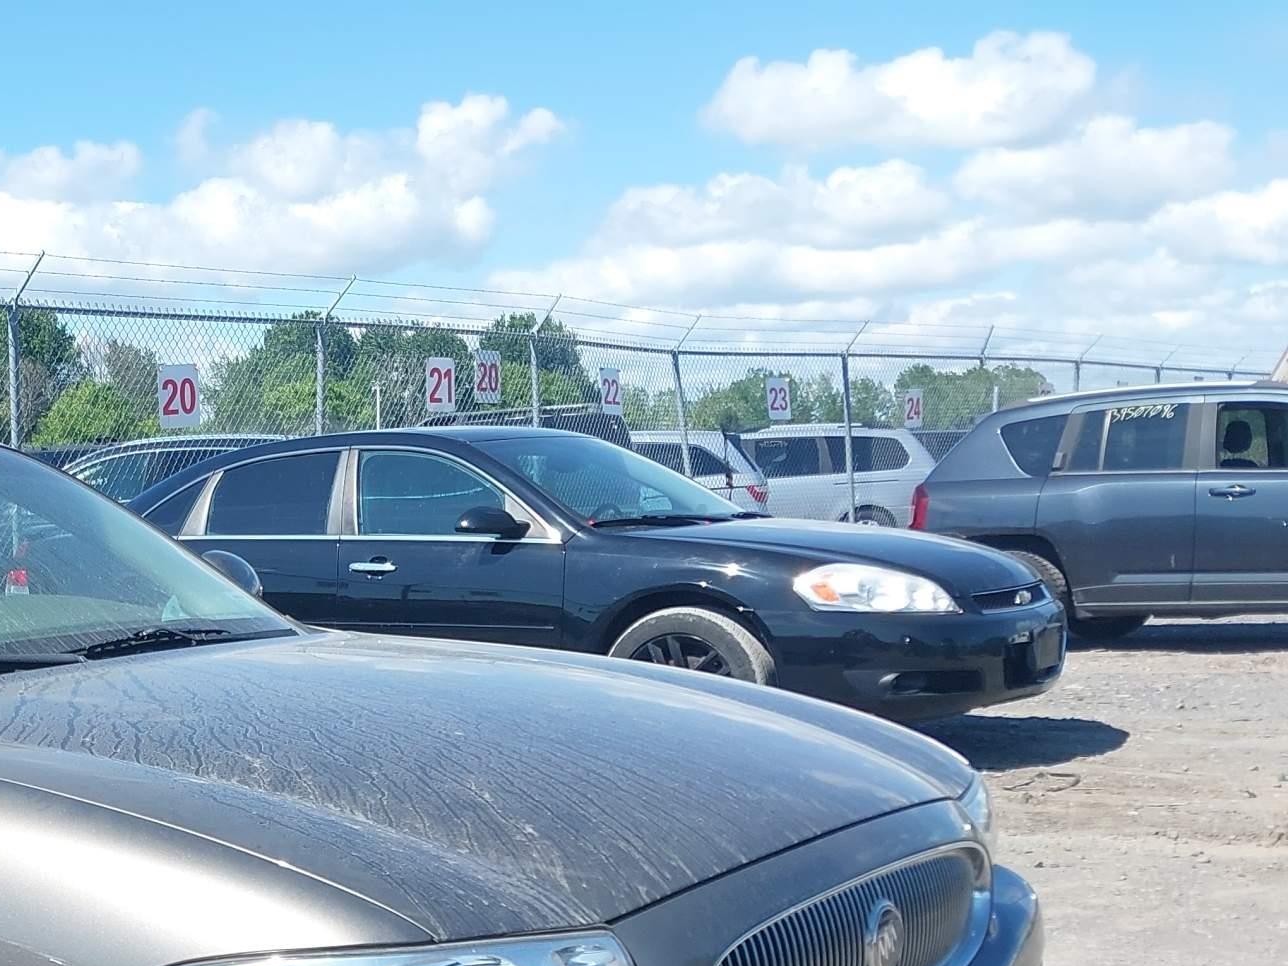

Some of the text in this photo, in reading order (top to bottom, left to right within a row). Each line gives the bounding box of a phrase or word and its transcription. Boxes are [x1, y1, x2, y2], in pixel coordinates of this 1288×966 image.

[429, 367, 453, 404] 21
[477, 362, 499, 393] 20
[162, 378, 196, 416] 20
[603, 378, 620, 405] 22
[769, 387, 788, 411] 23
[906, 397, 921, 420] 24
[1112, 404, 1178, 423] 39507096
